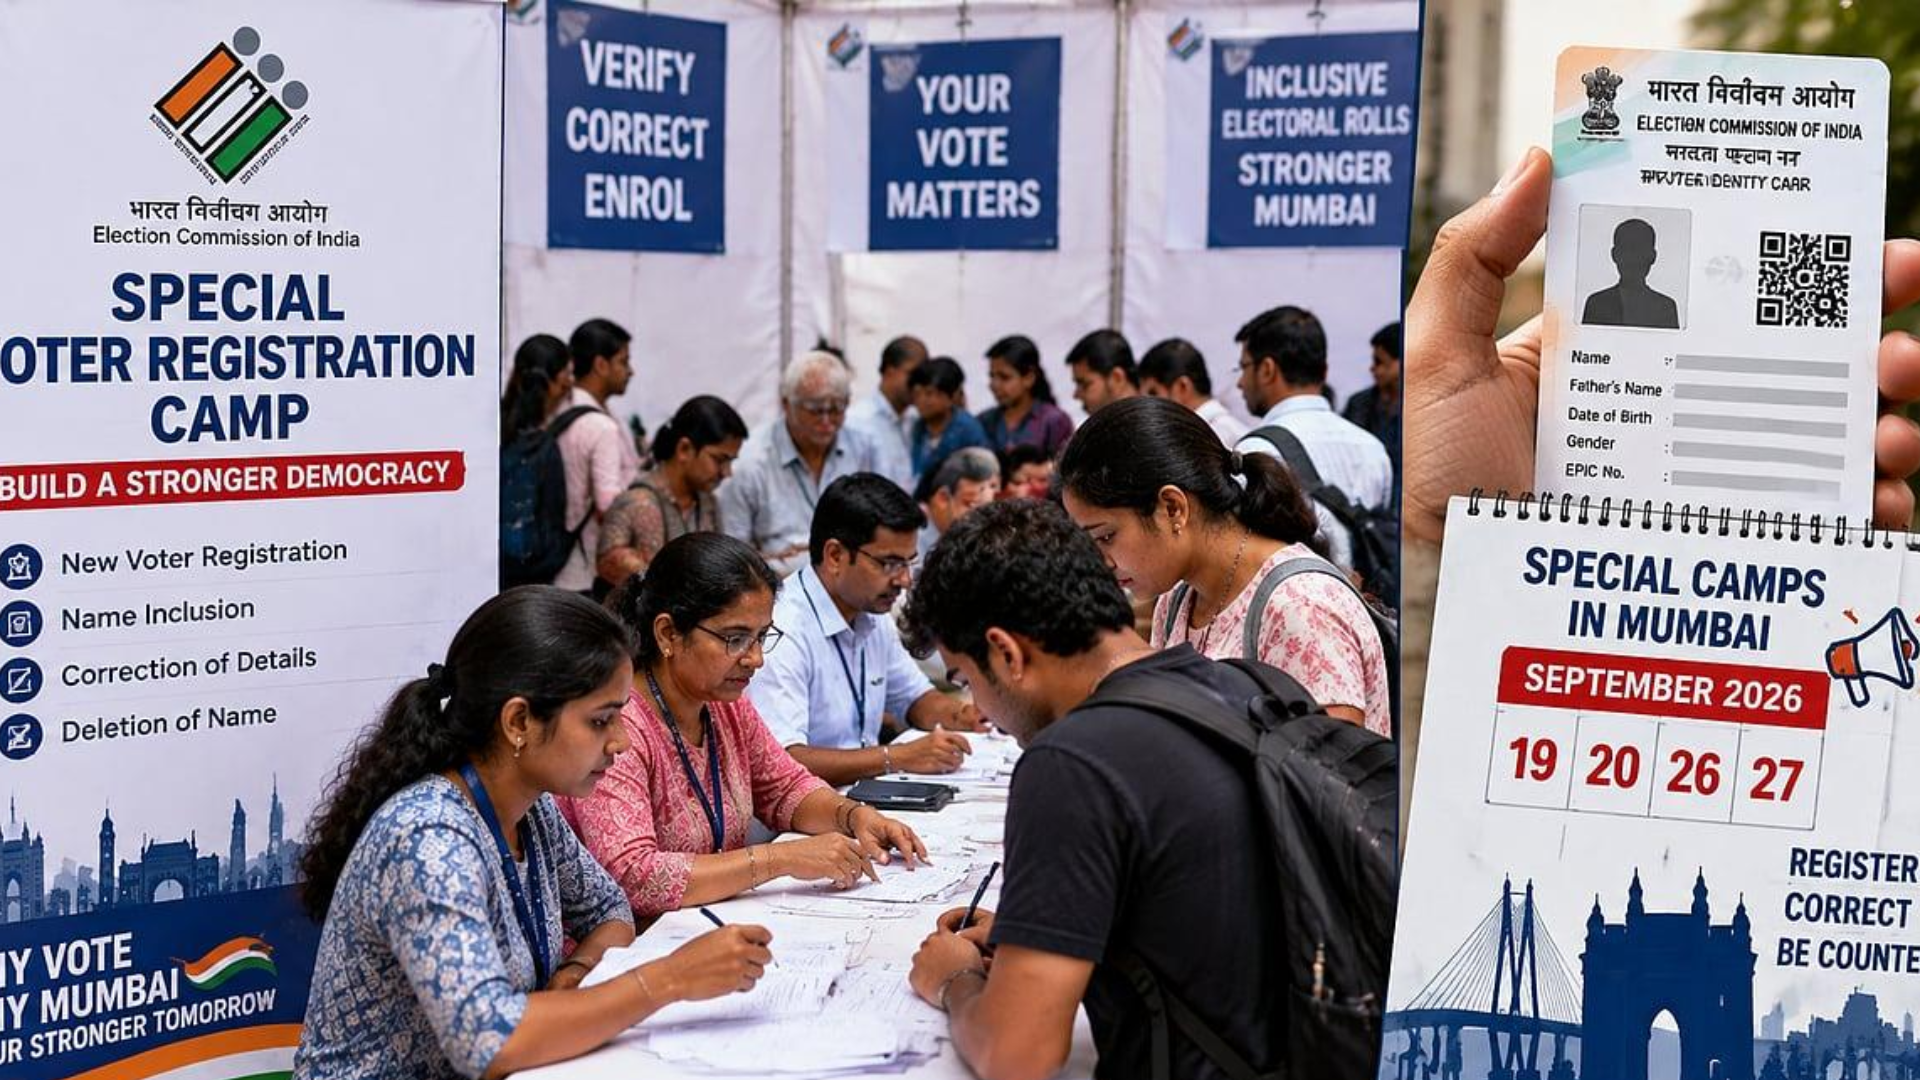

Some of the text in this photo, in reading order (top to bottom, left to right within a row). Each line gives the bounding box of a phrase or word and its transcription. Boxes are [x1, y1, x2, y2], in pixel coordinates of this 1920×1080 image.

[581, 39, 695, 94] VERIFY
[1246, 62, 1387, 98] INCLUSIVE
[917, 75, 1010, 113] YOUR
[567, 107, 709, 159] CORRECT
[1223, 105, 1409, 138] ELECTORAL ROLLS
[1802, 122, 1821, 137] OF
[1825, 123, 1862, 140] INDIA
[918, 127, 1008, 166] VOTE
[1240, 151, 1391, 185] STRONGER
[586, 174, 692, 221] ENROL
[888, 180, 1039, 218] MATTERS
[1255, 194, 1375, 226] MUMBAI
[94, 226, 359, 247] Election Commission of India
[112, 273, 344, 321] SPECIAL
[0, 334, 474, 384] OTER REGISTRATION
[1572, 350, 1610, 364] Name
[1625, 382, 1662, 396] Name
[151, 394, 309, 443] CAMP
[1569, 407, 1652, 424] Date of Birth
[1567, 435, 1615, 450] Gender
[0, 460, 449, 501] BUILD A STRONGER DEMOCRACY
[1566, 463, 1624, 478] EPIC No.
[62, 540, 346, 574] New Voter Registration
[1524, 547, 1826, 608] SPECIAL CAMPS
[63, 599, 254, 630] Name Inclusion
[1569, 601, 1770, 650] IN MUMBAI
[62, 647, 316, 686] Correction of Details
[1525, 664, 1801, 712] SEPTEMBER 2026
[63, 708, 276, 742] Deletion of Name
[1510, 737, 1557, 781] 19
[1586, 744, 1639, 788] 20
[1667, 750, 1720, 795] 26
[1750, 757, 1804, 801] 27
[1790, 848, 1918, 883] REGISTER
[1785, 892, 1912, 928] CORRECT
[43, 932, 131, 979] VOTE
[1777, 938, 1810, 967] BE
[0, 967, 179, 1031] Y MUMBAI
[31, 1015, 146, 1057] STRONGER
[153, 988, 275, 1032] TOMORROW
